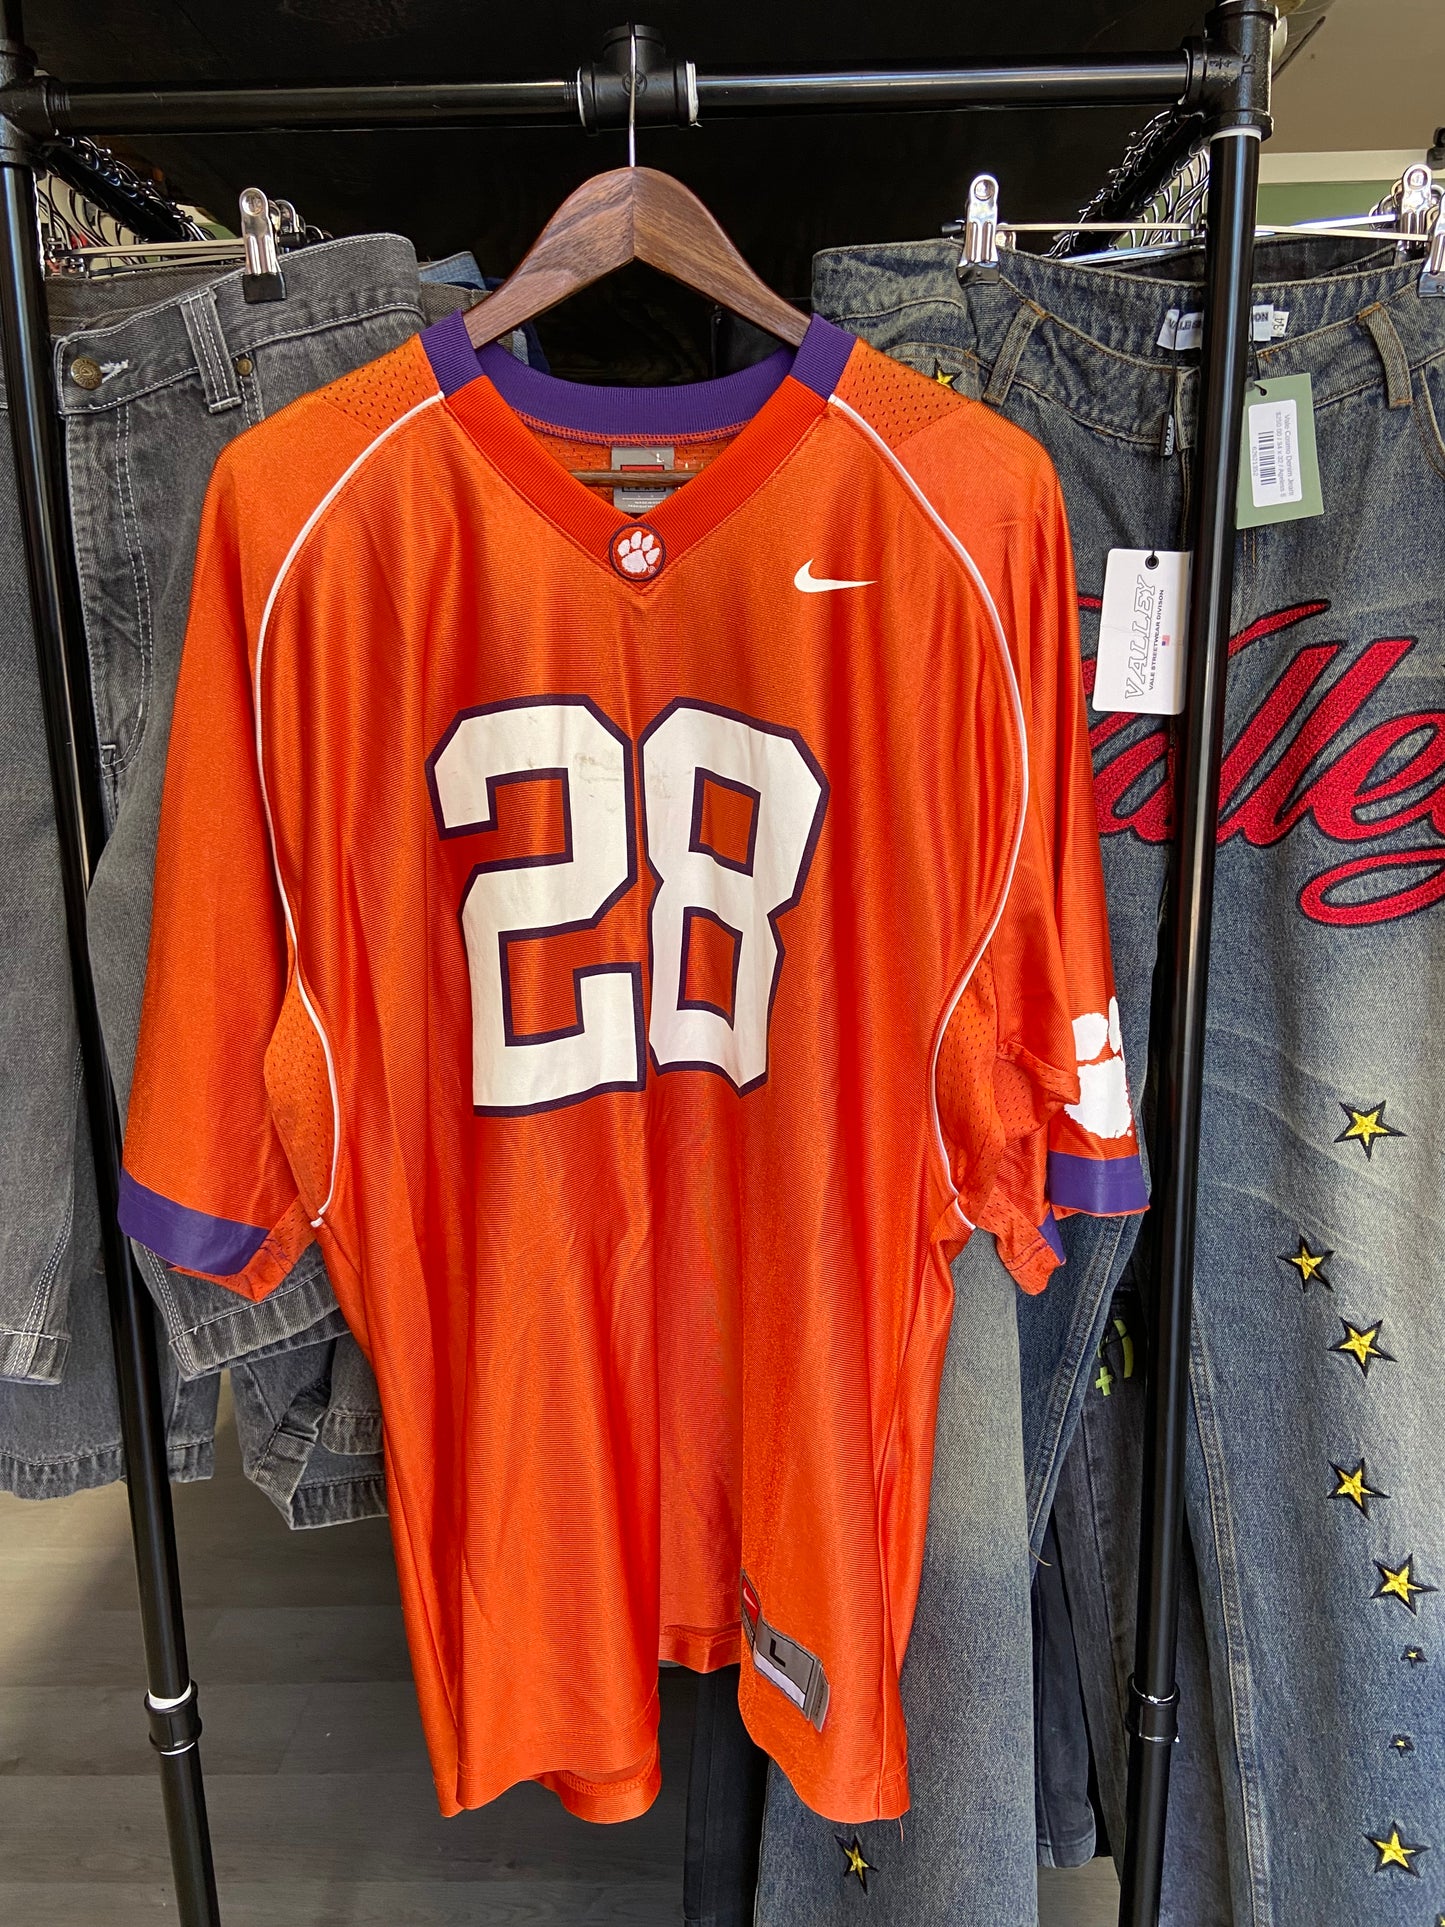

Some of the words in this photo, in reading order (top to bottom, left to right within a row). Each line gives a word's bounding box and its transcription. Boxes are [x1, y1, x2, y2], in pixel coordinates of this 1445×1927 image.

[656, 453, 665, 463] L
[1284, 430, 1292, 455] Cosmo
[1125, 574, 1156, 699] VALLEY
[1151, 621, 1161, 671] STREETWEAR
[1156, 589, 1165, 620] DIVISON
[424, 694, 831, 1118] 28
[769, 1638, 786, 1668] L
